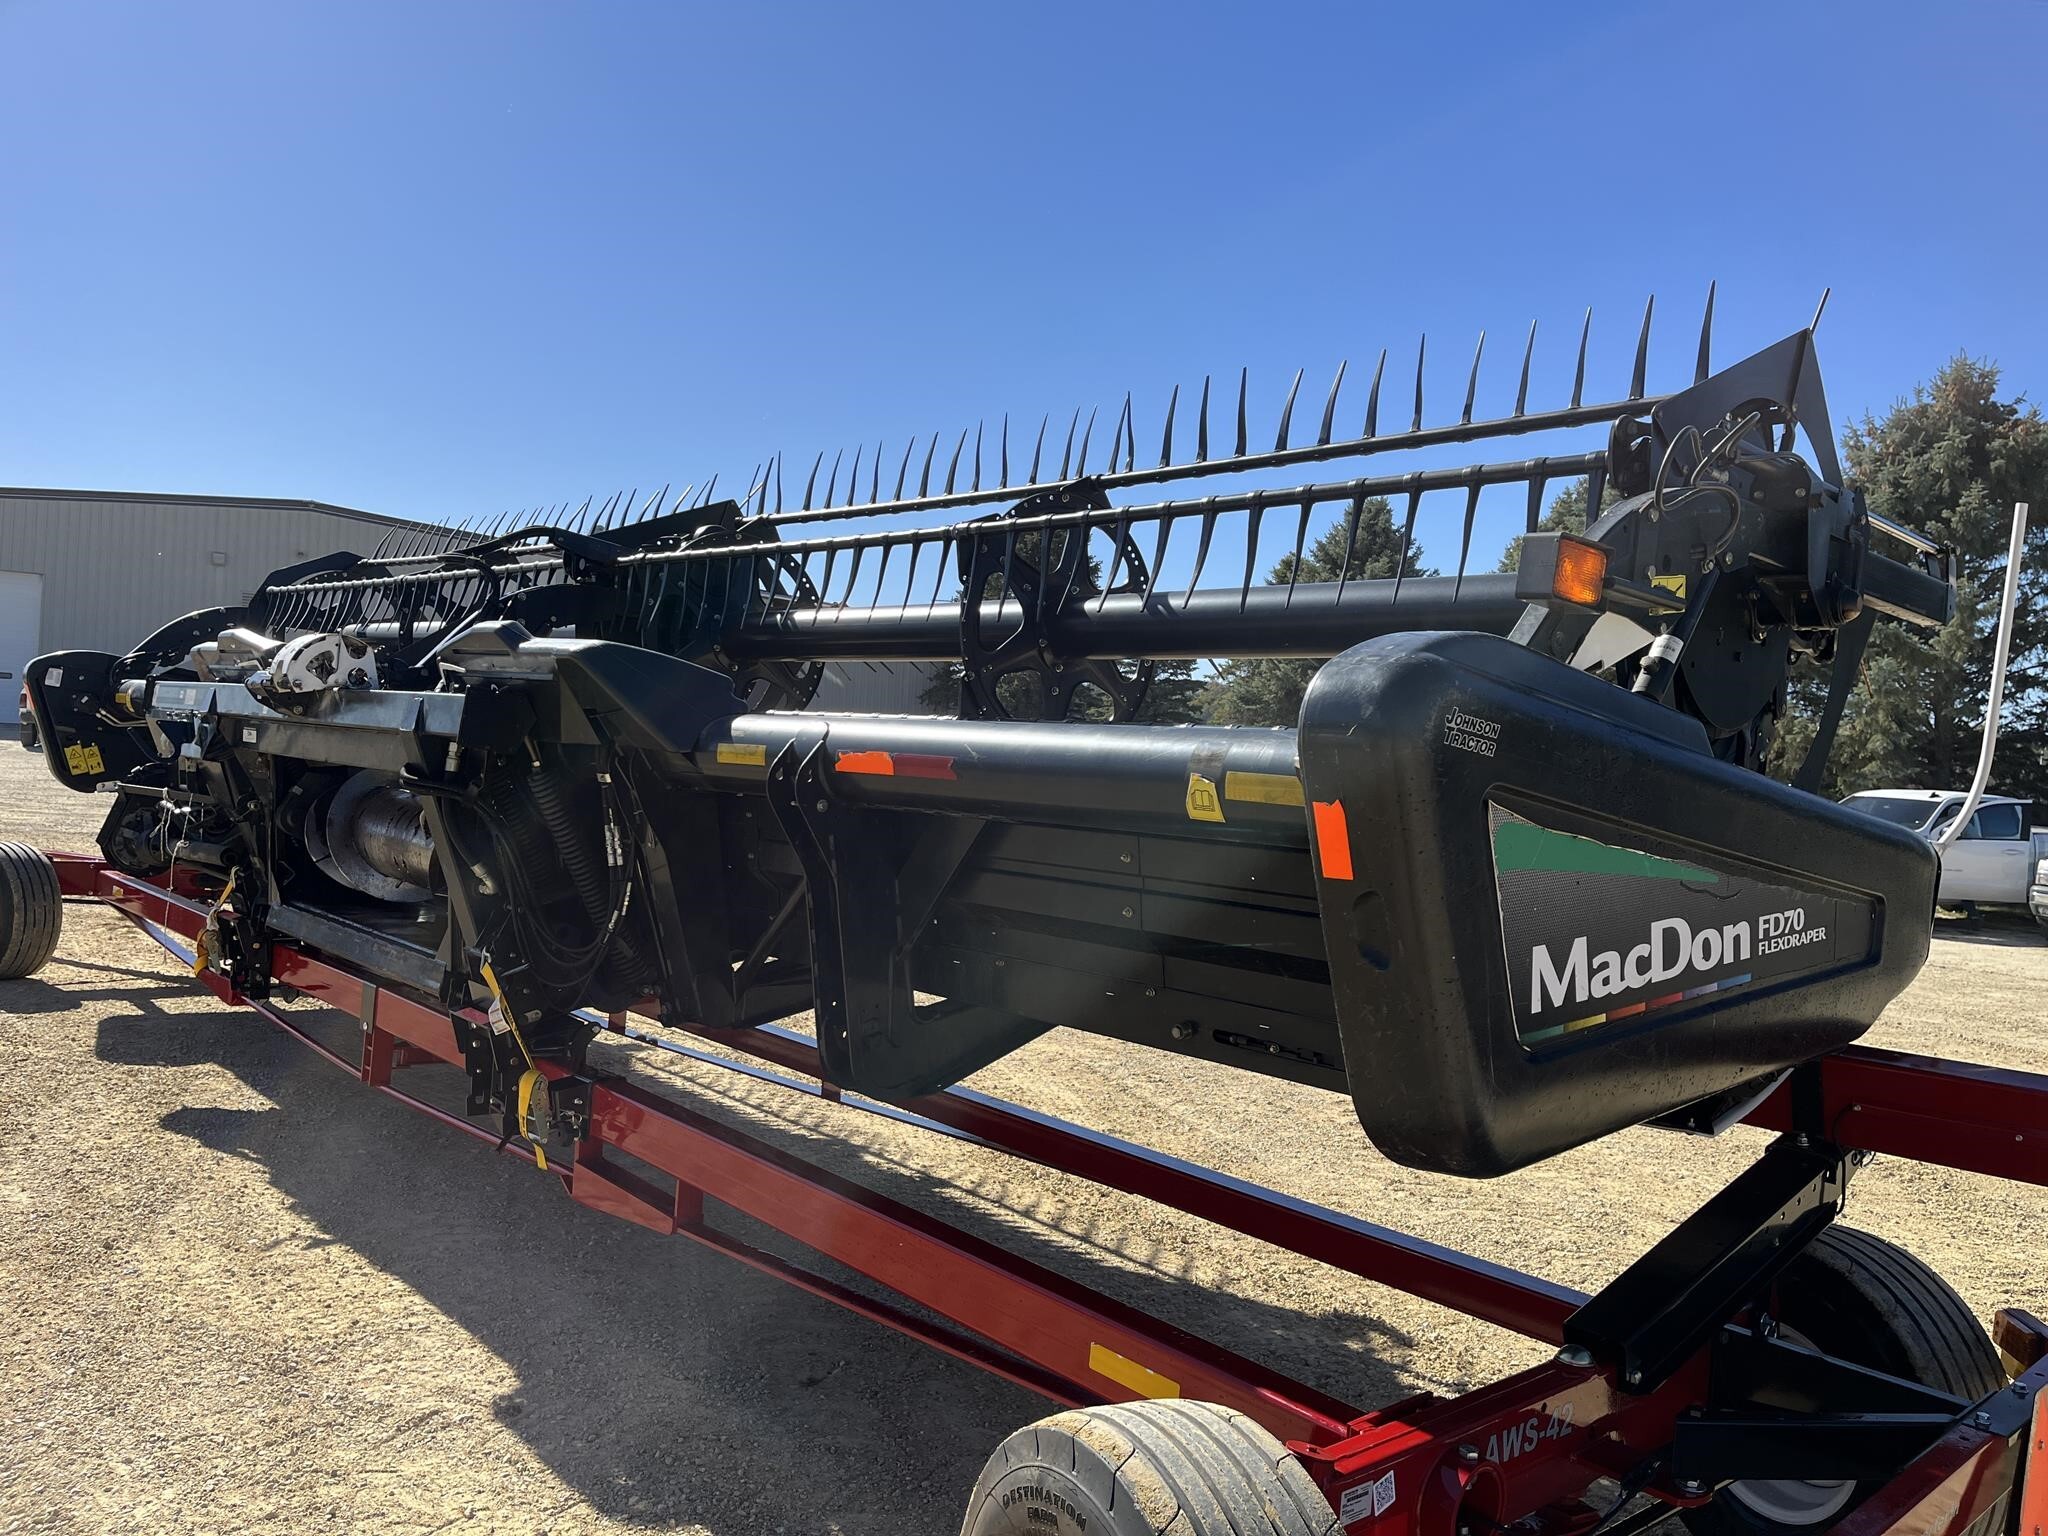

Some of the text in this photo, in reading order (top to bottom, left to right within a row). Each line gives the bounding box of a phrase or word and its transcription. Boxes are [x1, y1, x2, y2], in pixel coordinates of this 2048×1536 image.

[1445, 706, 1501, 738] JOHNSON
[1444, 726, 1497, 757] TRACTOR
[1758, 908, 1805, 939] FD70
[1758, 927, 1827, 955] FLEXDRAPER
[1531, 917, 1751, 1014] MacDon
[1486, 1402, 1574, 1464] AWS-42
[1002, 1484, 1087, 1532] DESTINATION
